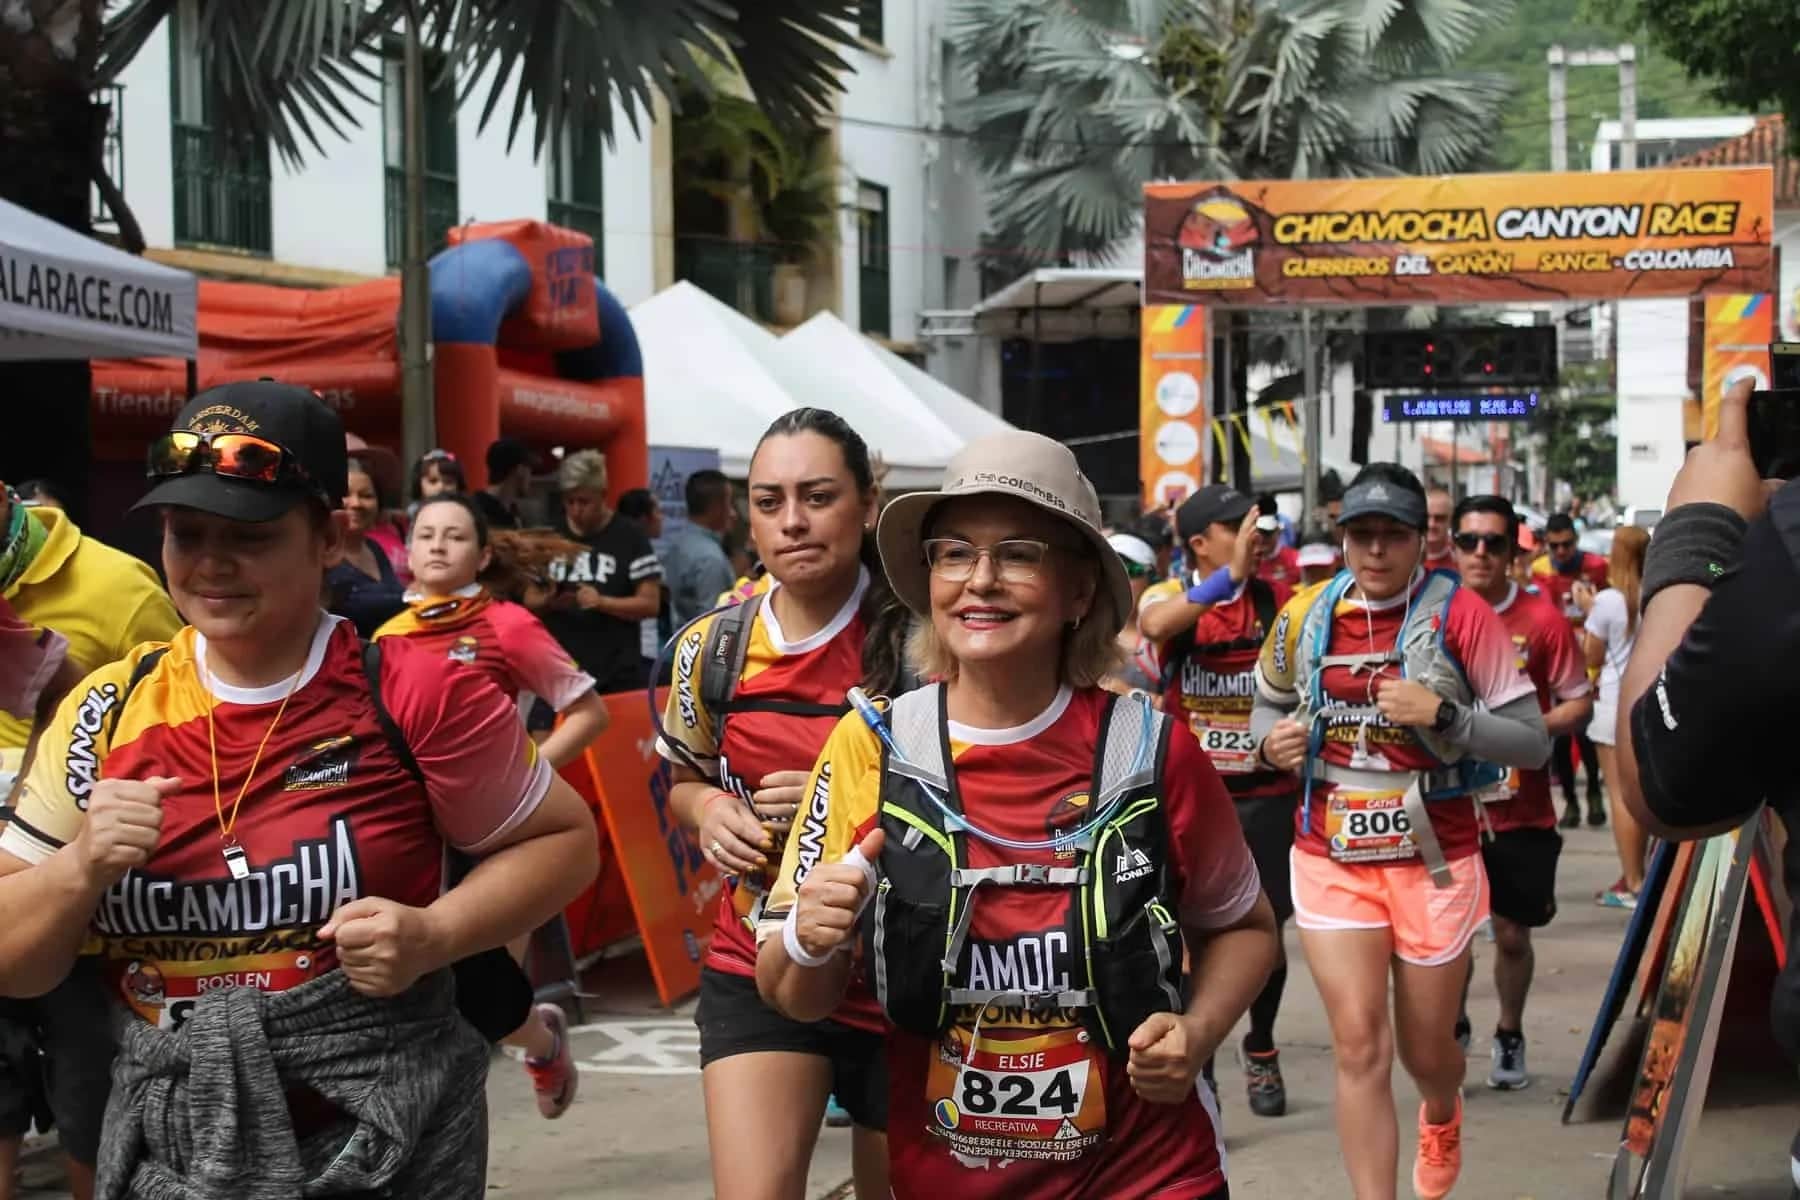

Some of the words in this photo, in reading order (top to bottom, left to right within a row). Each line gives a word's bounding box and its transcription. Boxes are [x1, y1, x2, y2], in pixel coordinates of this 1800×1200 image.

[1274, 211, 1488, 244] CHICAMOCHA
[1497, 205, 1642, 239] CANYON
[1650, 203, 1738, 234] RACE
[1283, 256, 1390, 277] GUERREROS
[1395, 255, 1431, 275] DEL
[1624, 248, 1735, 271] COLOMBIA
[548, 551, 617, 583] GAP
[1207, 731, 1257, 751] 823
[1349, 809, 1411, 836] 806
[197, 971, 271, 993] ROSLEN
[999, 1052, 1046, 1070] ELSIE
[962, 1069, 1079, 1116] 824
[975, 1119, 1039, 1134] RECREATIVA
